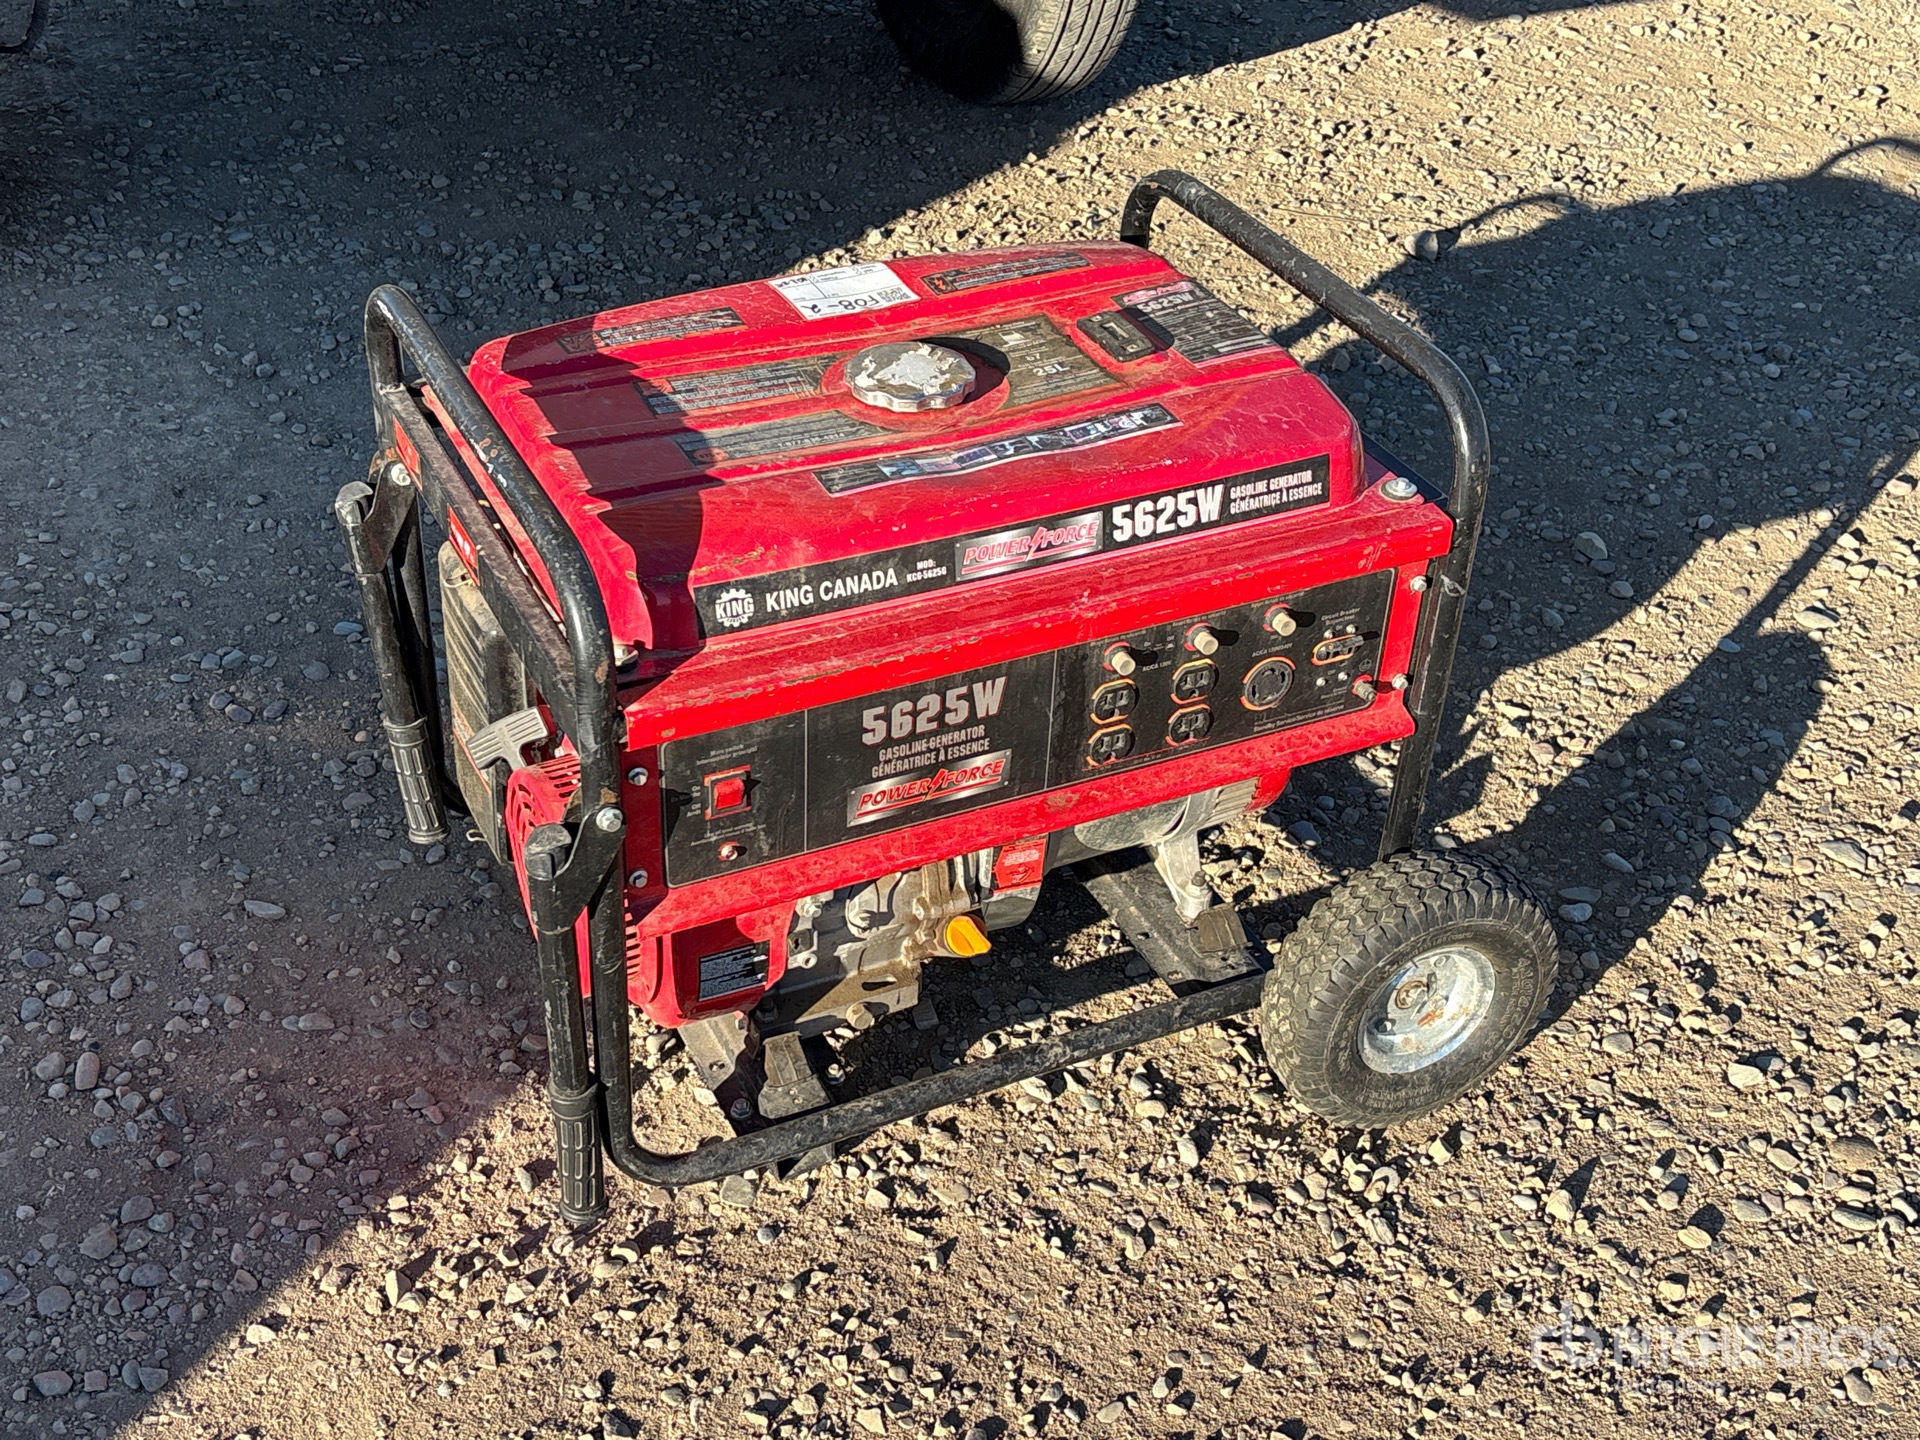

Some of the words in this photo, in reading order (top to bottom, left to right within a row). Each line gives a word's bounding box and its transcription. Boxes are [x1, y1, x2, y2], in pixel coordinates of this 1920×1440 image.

[1137, 292, 1194, 313] 5625W
[1033, 364, 1070, 376] 25L
[1230, 479, 1268, 499] GASOLINE
[1269, 470, 1313, 492] GENERATOR
[1230, 492, 1281, 515] GÉNÉRATRICE
[1281, 485, 1288, 498] À
[1289, 482, 1323, 501] ESSENCE
[1112, 483, 1225, 543] 5625W
[963, 535, 1031, 566] POWER
[1041, 519, 1100, 549] FORCE
[916, 559, 937, 570] MOD:
[715, 598, 754, 619] KING
[766, 585, 814, 612] KING
[819, 567, 899, 602] CANADA
[862, 676, 1008, 747] 5625W
[872, 752, 937, 779] GÉNÉRATRICE
[938, 746, 946, 762] À
[947, 738, 990, 760] ESSENCE
[879, 739, 928, 762] GASOLINE
[929, 724, 986, 750] GENERATOR
[858, 778, 932, 810] POWER
[942, 758, 1006, 788] FORCE
